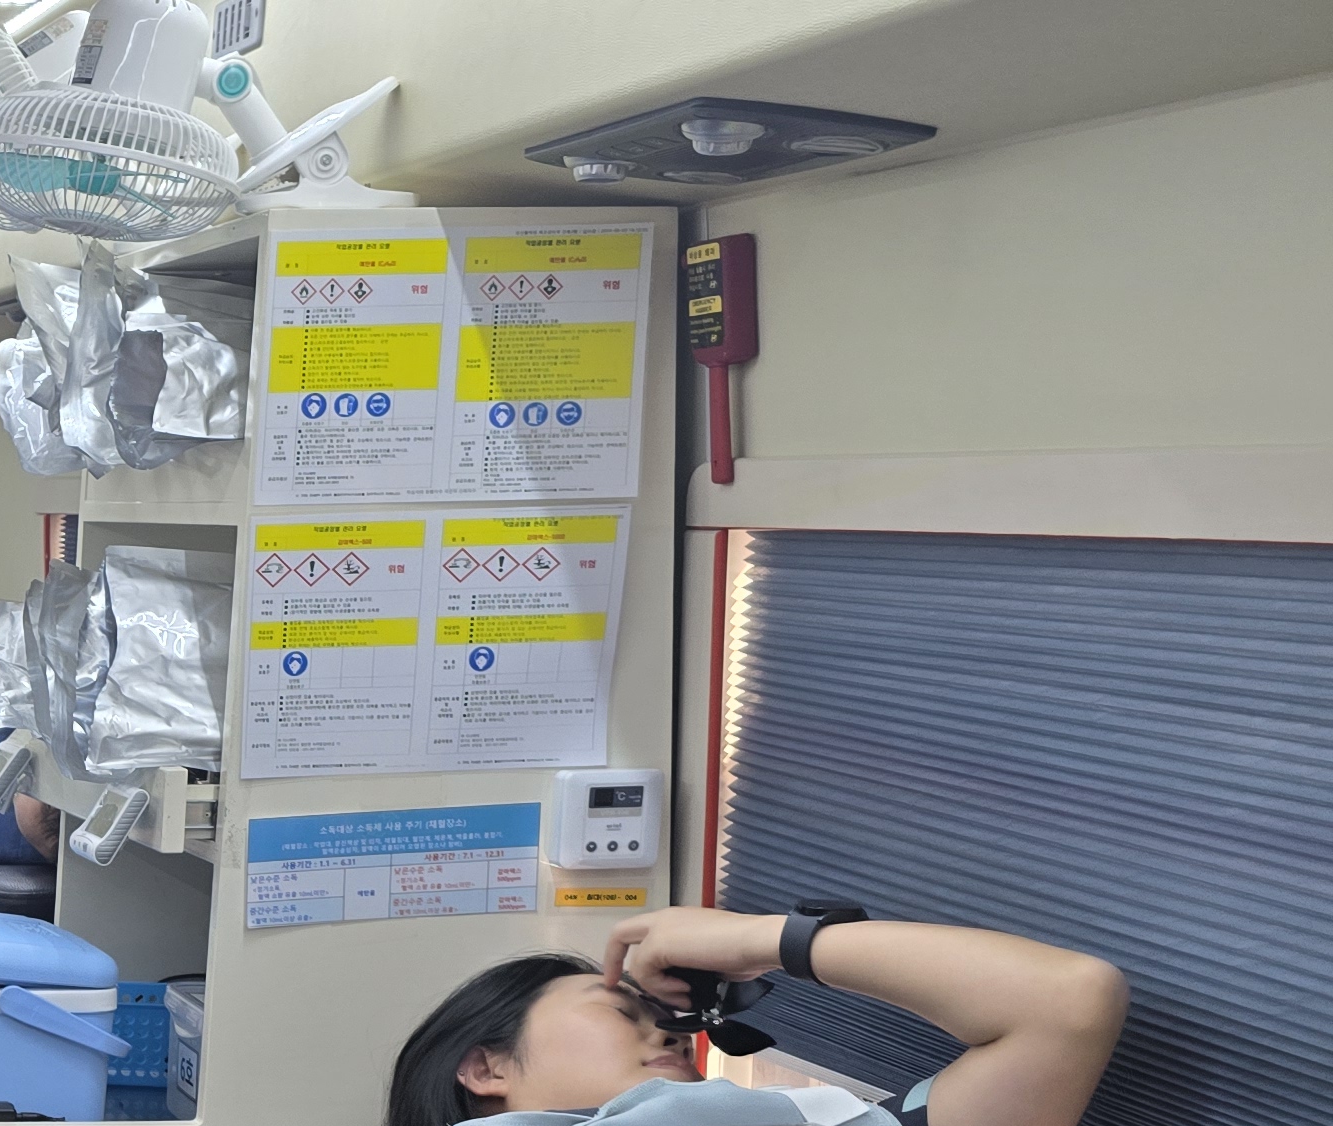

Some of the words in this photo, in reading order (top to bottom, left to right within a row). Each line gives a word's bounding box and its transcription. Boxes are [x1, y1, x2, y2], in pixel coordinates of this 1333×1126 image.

[411, 284, 429, 295] 위험
[602, 280, 621, 290] 위험
[388, 564, 405, 574] 위험
[579, 559, 596, 569] 위험
[319, 825, 354, 835] 소독대상
[384, 821, 402, 832] 사용
[405, 820, 422, 830] 주기
[424, 852, 456, 861] 사용기간
[462, 851, 474, 859] 7.1
[484, 850, 505, 858] 12.31
[281, 860, 312, 870] 사용기간
[319, 859, 330, 867] 1.1
[340, 858, 356, 866] 6.31
[394, 866, 425, 876] 낮은수준
[427, 865, 443, 873] 소독
[250, 875, 280, 885] 낮은수준
[282, 873, 298, 882] 소독
[249, 905, 280, 916] 중간수준
[282, 904, 297, 913] 소독
[180, 1057, 194, 1087] 6호
